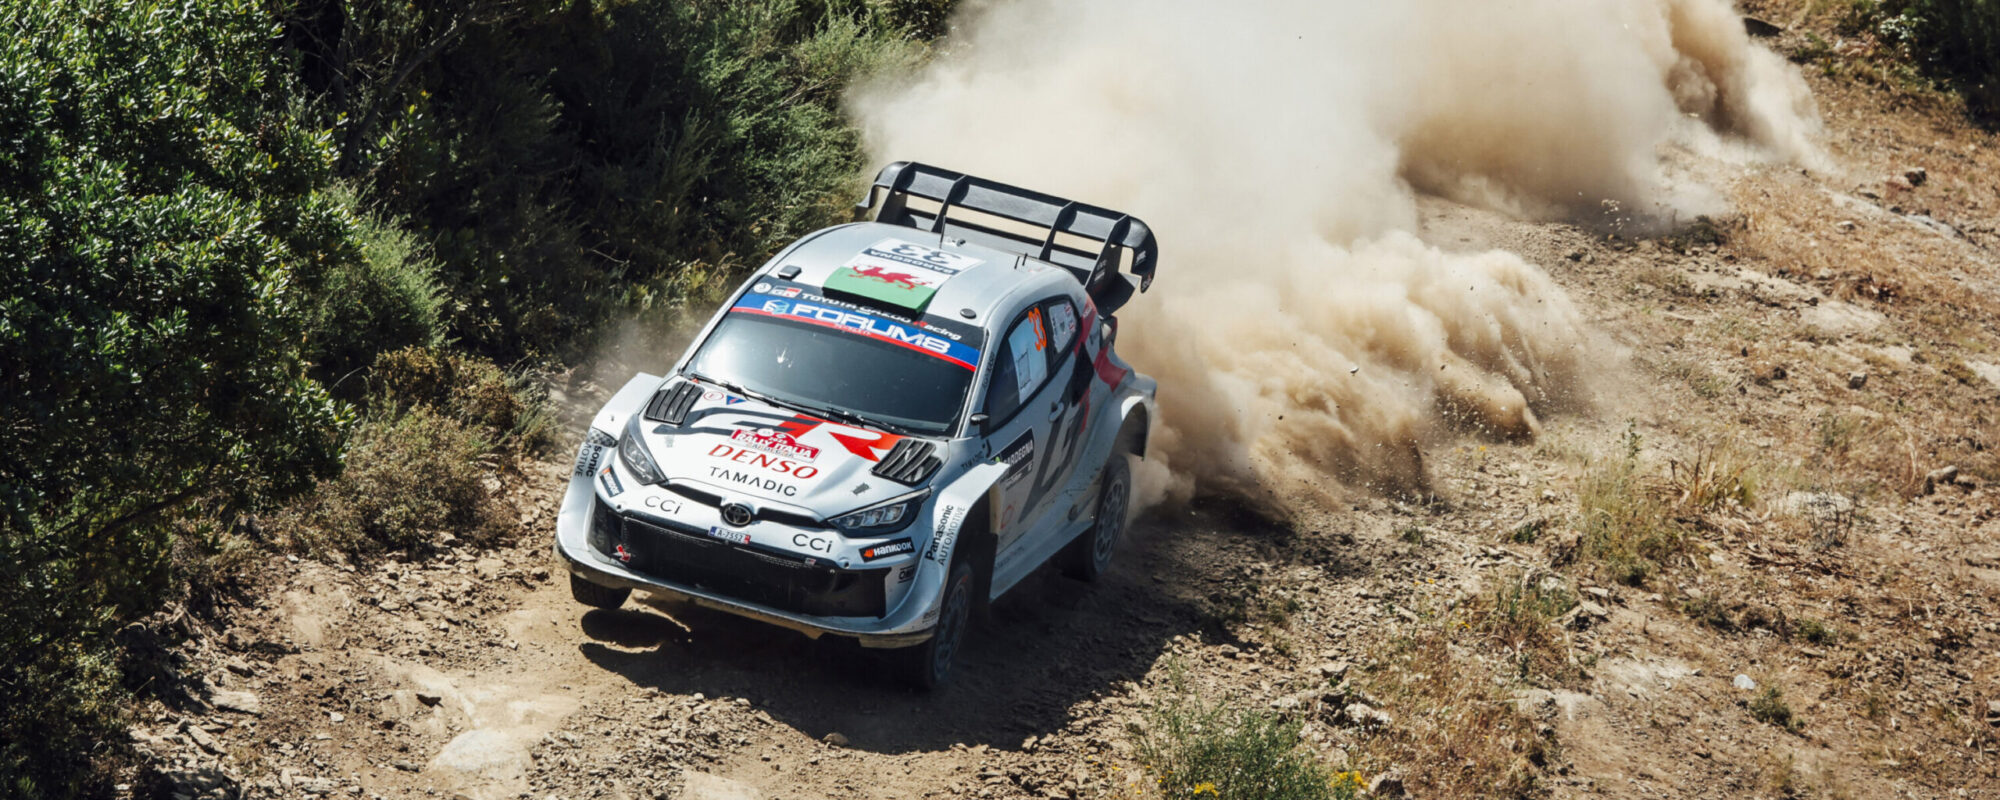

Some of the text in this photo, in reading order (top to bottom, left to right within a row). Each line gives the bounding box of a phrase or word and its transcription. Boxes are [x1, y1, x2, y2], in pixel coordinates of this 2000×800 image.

[868, 249, 956, 274] SARDEGNA
[891, 244, 962, 264] 33
[791, 303, 952, 354] FORUM8
[1028, 307, 1047, 352] 33
[708, 444, 819, 479] DENSO
[737, 433, 814, 459] RALLY ITALIA
[710, 466, 798, 497] TAMADIC
[925, 504, 955, 561] Panasonic
[937, 506, 967, 566] AUTOMOTIVE
